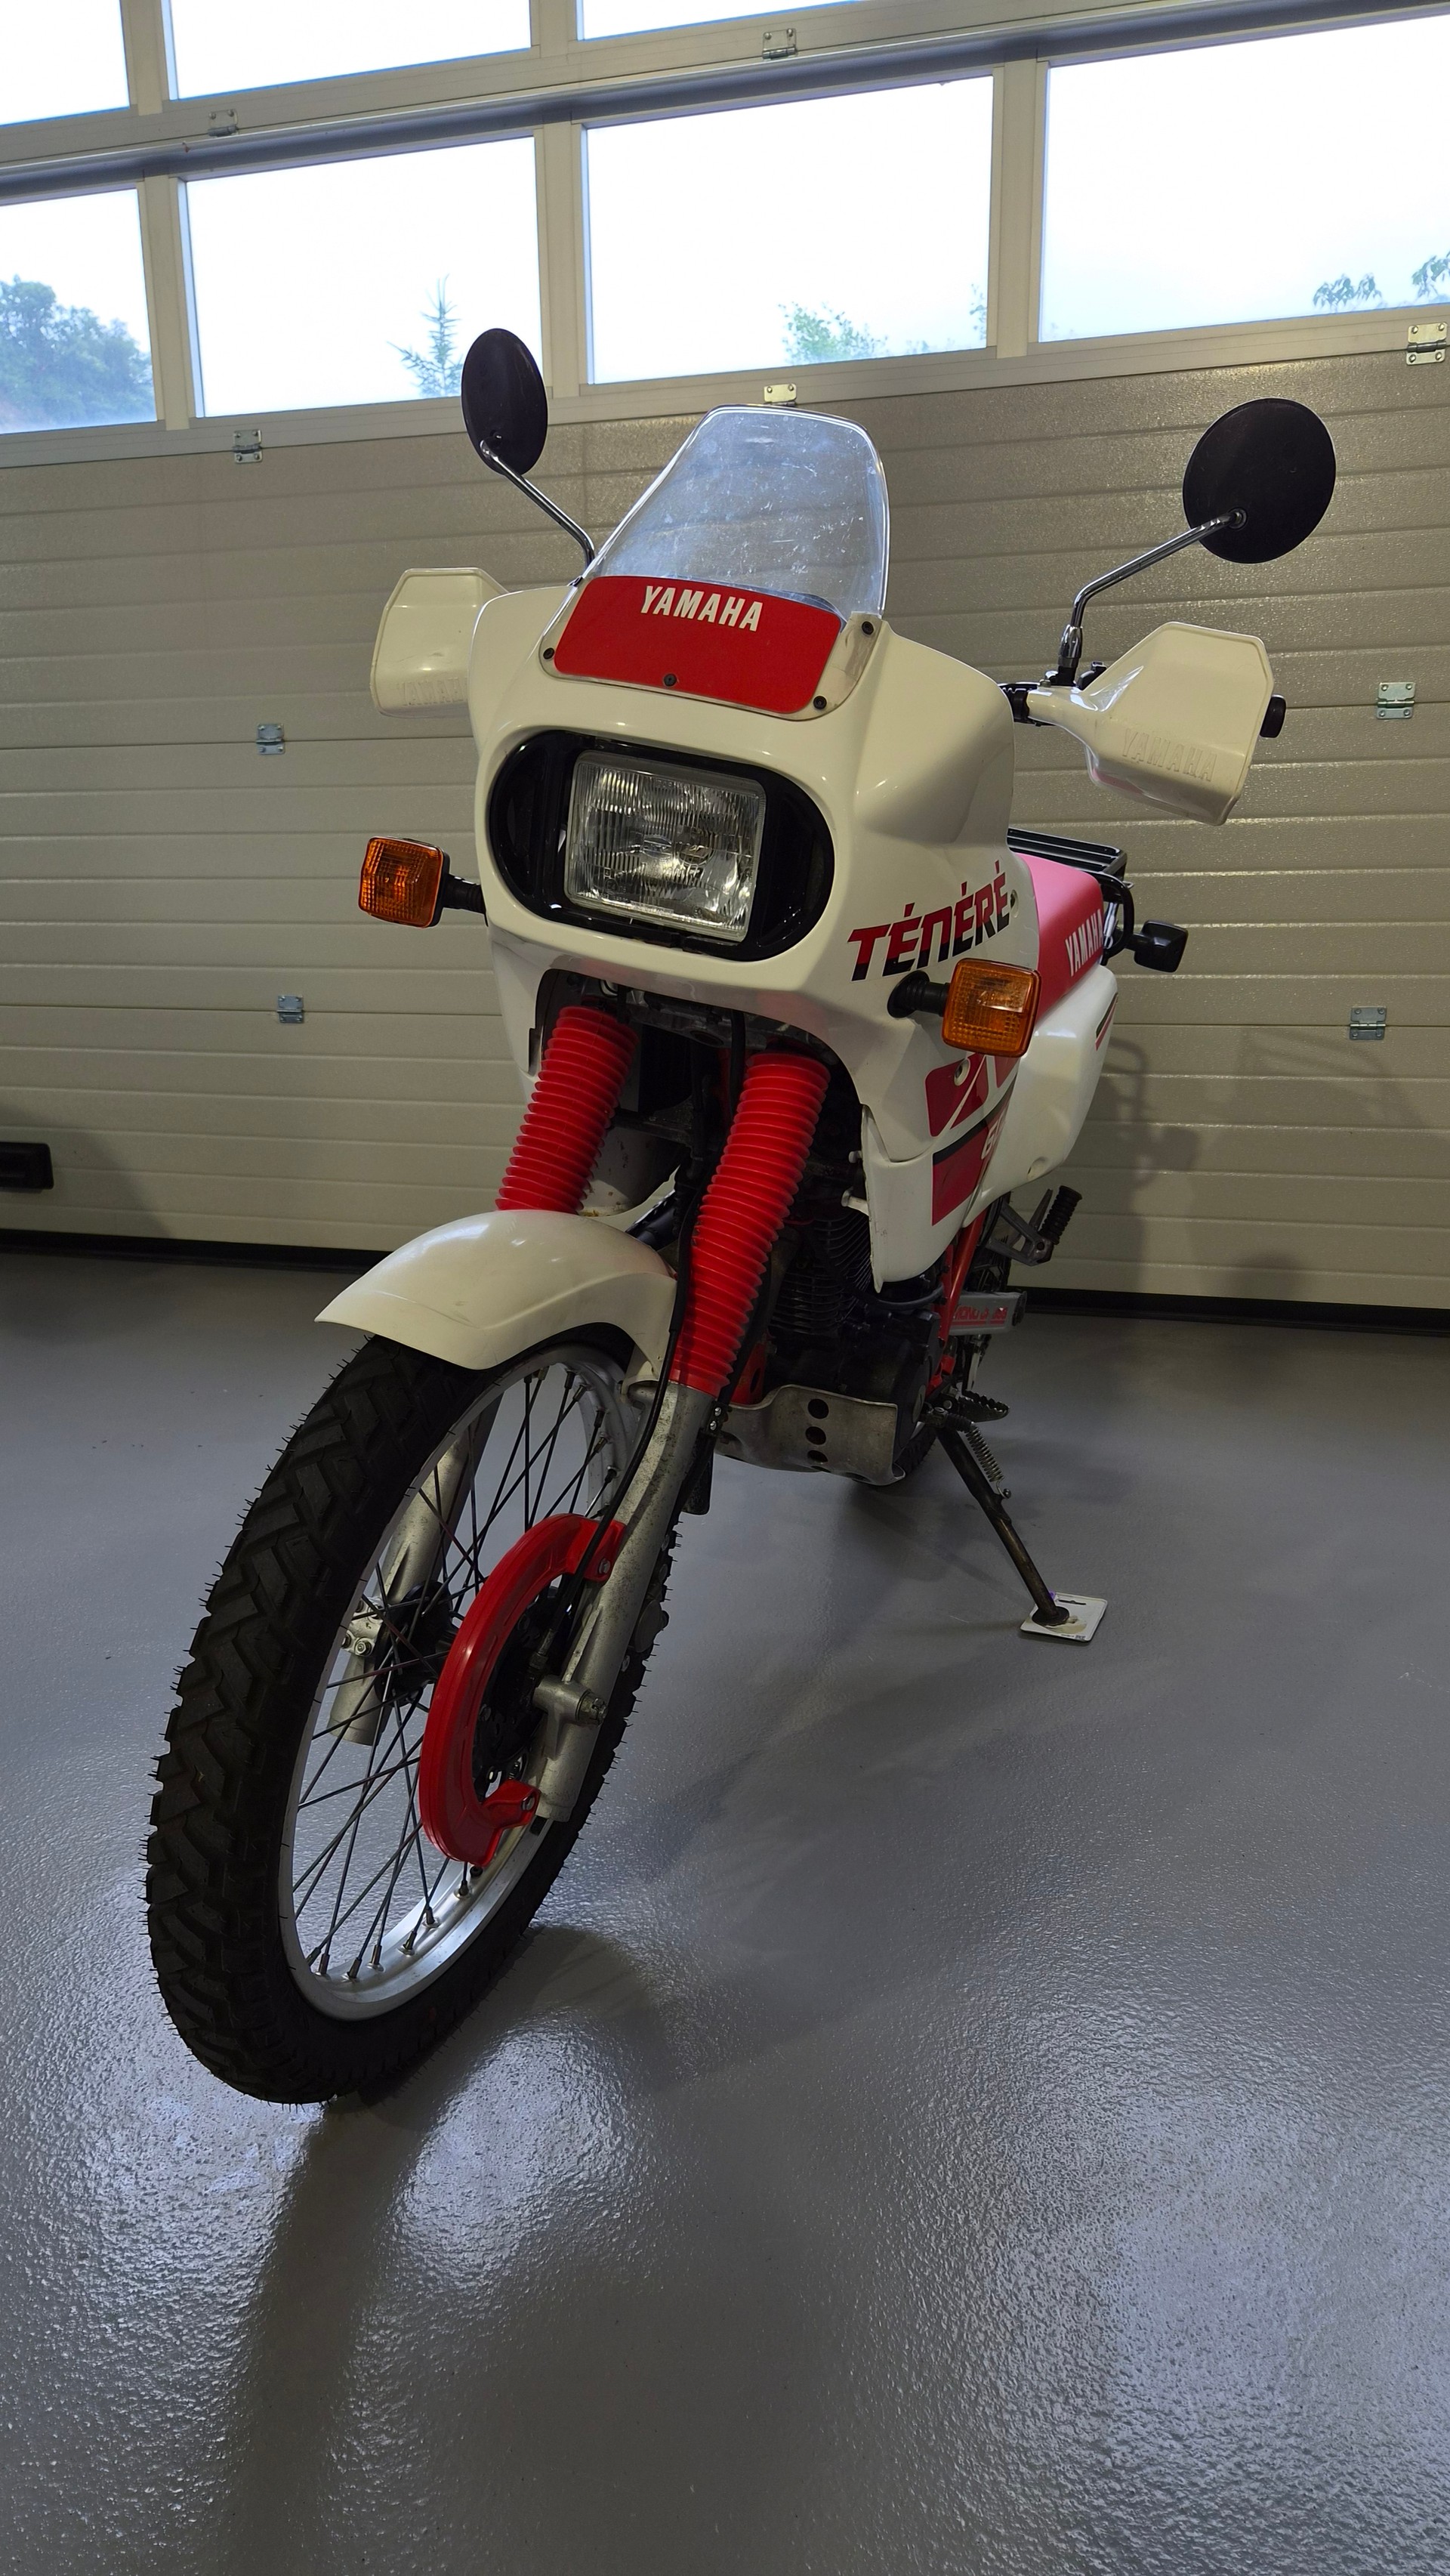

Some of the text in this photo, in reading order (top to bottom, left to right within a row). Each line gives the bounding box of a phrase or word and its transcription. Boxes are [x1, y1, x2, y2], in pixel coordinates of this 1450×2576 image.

[640, 585, 764, 632] YAMAHA
[396, 677, 468, 706] YAMAH
[1122, 727, 1217, 782] YAMAHA
[847, 859, 1010, 981] TÉNÉRÉ
